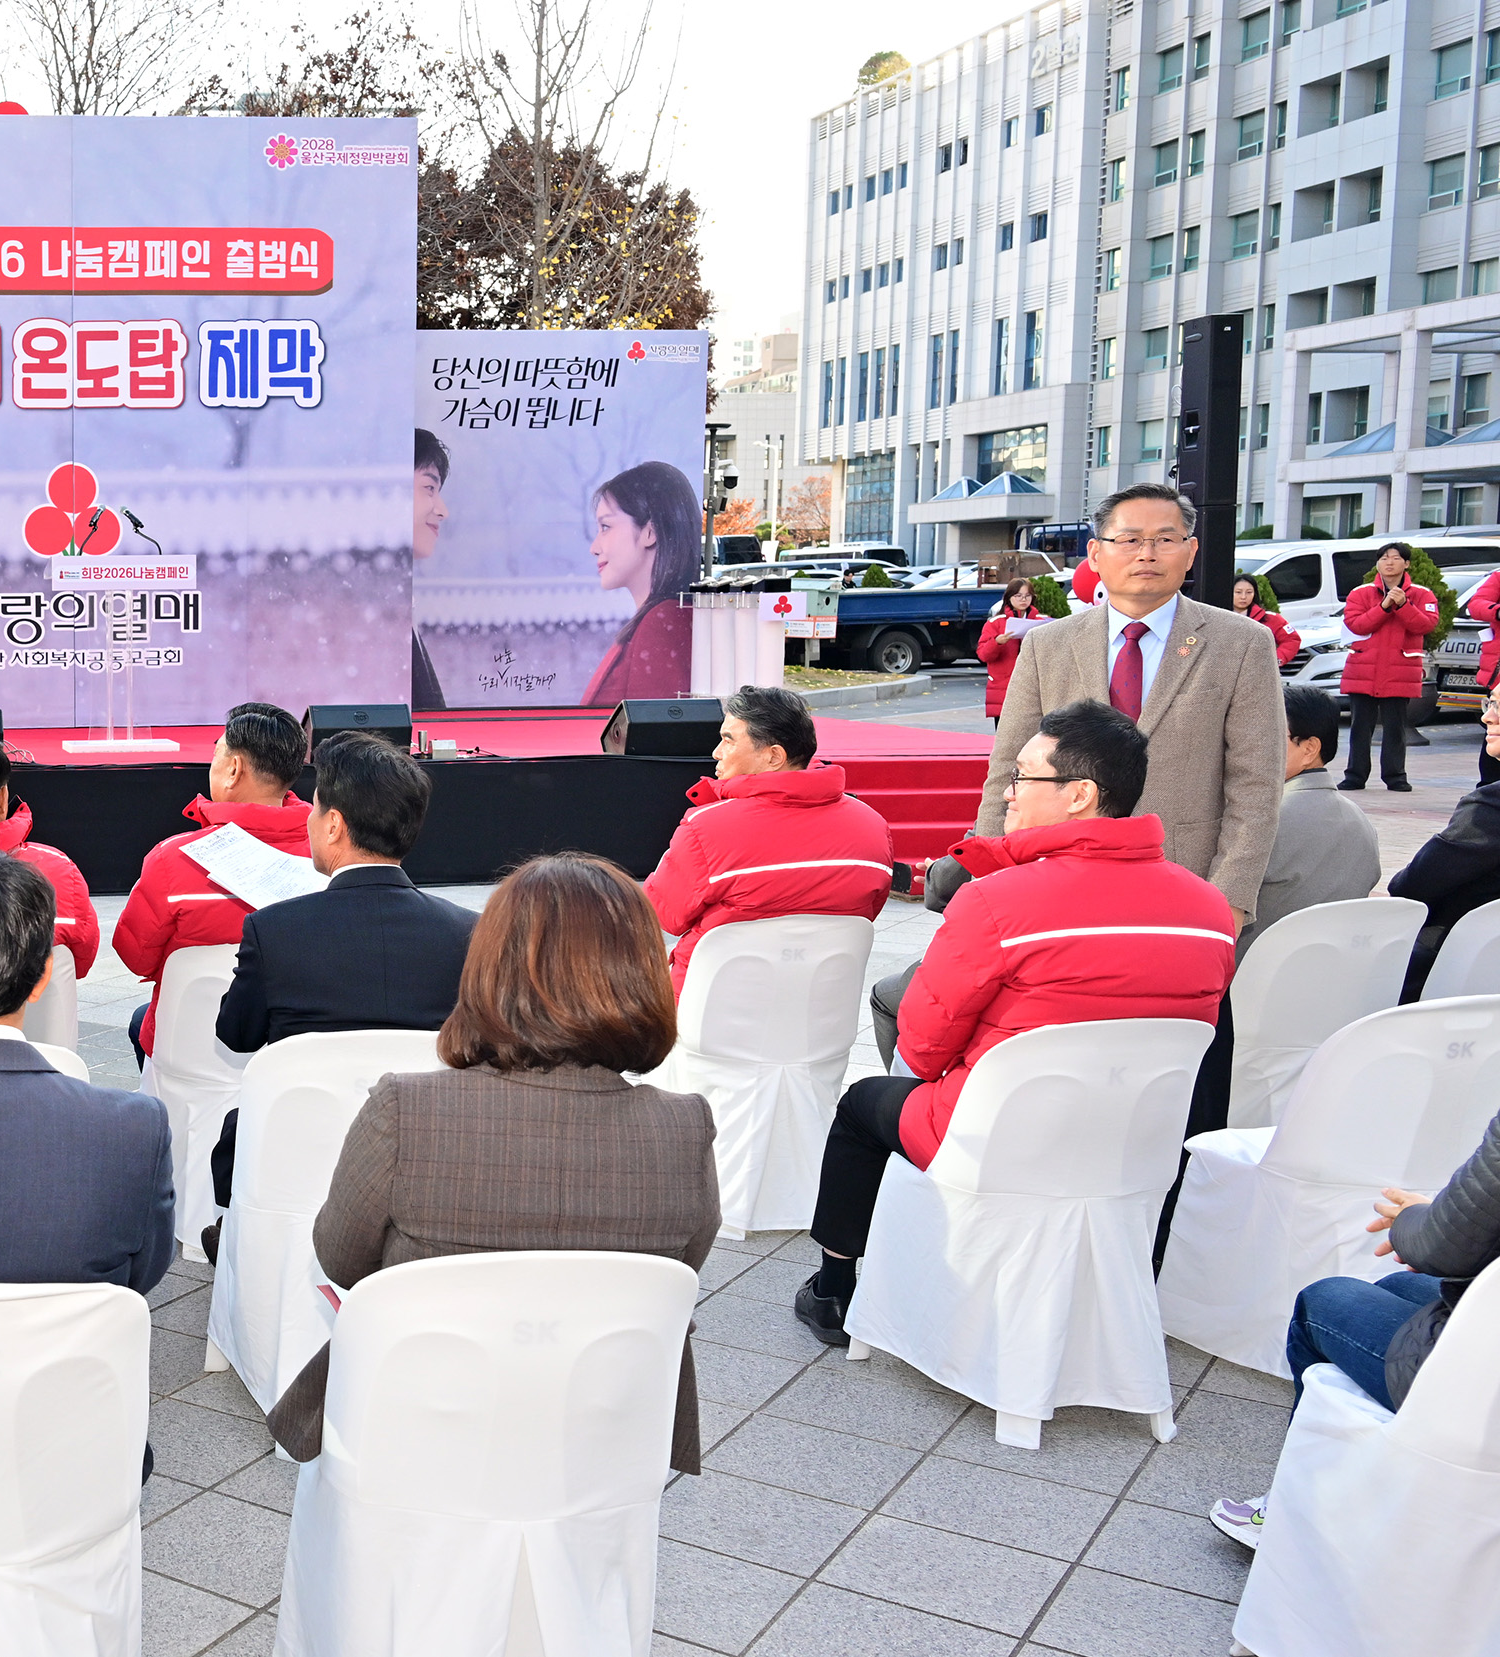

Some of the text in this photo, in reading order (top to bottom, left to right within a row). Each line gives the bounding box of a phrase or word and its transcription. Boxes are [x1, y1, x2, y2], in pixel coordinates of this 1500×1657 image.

[301, 139, 334, 151] 2028
[301, 152, 409, 165] 울산국제정원박람회
[41, 239, 211, 279] 나눔캠페인
[226, 239, 318, 279] 출범식
[20, 326, 180, 400] 온도탑
[206, 327, 317, 400] 제막
[431, 356, 620, 391] 당신의 따뜻함에
[441, 396, 605, 430] 가슴이 뜁니다
[81, 566, 189, 580] 희망2026나눔캠페인
[780, 947, 806, 961] SK
[1445, 1040, 1477, 1060] SK
[512, 1319, 562, 1345] SK
